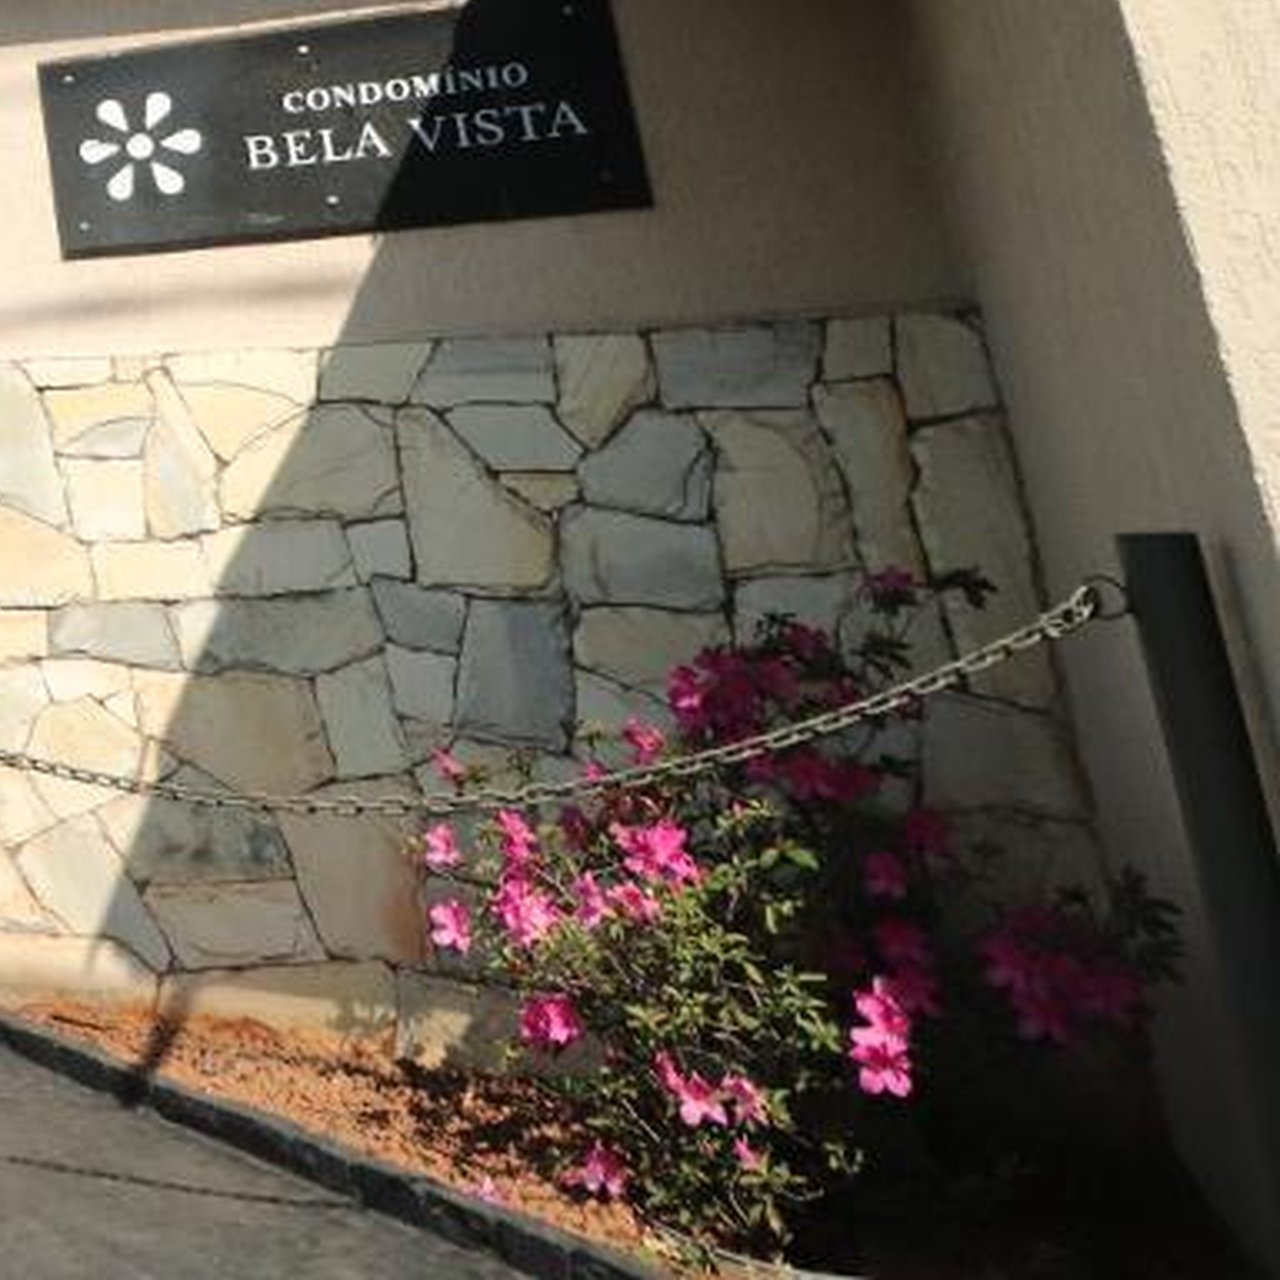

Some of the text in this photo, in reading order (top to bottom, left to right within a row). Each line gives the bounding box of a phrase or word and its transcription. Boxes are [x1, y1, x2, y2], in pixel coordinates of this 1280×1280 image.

[282, 62, 529, 114] CONDOMÍNIO
[243, 101, 589, 170] BELA VISTA
